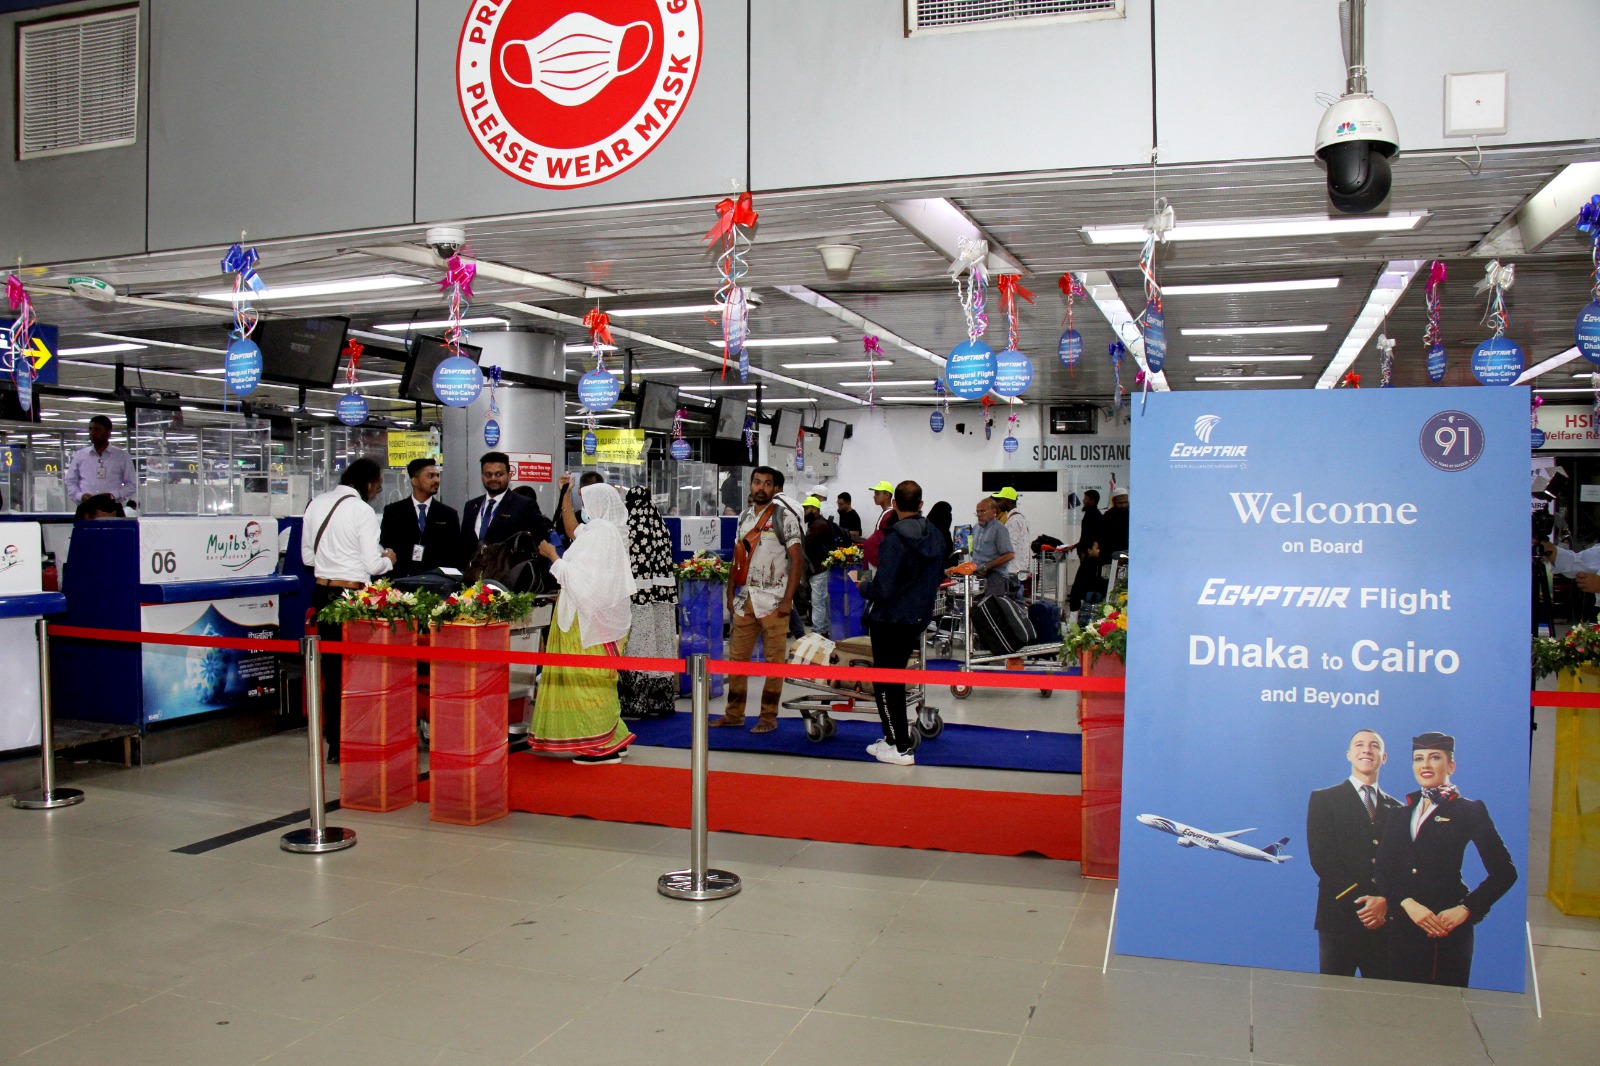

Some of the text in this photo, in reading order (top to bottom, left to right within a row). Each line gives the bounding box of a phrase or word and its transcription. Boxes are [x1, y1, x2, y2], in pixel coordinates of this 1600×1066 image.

[466, 53, 691, 179] PLEASE WEAR MASK
[952, 354, 985, 363] EGYPTAIR
[948, 370, 995, 380] Inaugural Flight
[953, 379, 990, 387] Dhaka-Cairo
[1170, 443, 1248, 457] EGYPTAIR
[1435, 427, 1469, 456] 91
[1033, 445, 1077, 461] SOCIAL
[1229, 491, 1418, 525] Welcome
[206, 534, 247, 558] Mujibs
[683, 534, 691, 546] 03
[1282, 538, 1363, 554] on Board
[151, 551, 177, 575] 06
[1197, 578, 1451, 615] EGYPTAIR Flight
[1189, 635, 1460, 674] Dhaka to Cairo
[1260, 687, 1380, 708] and Beyond
[1182, 827, 1219, 846] EGYPTAIR
